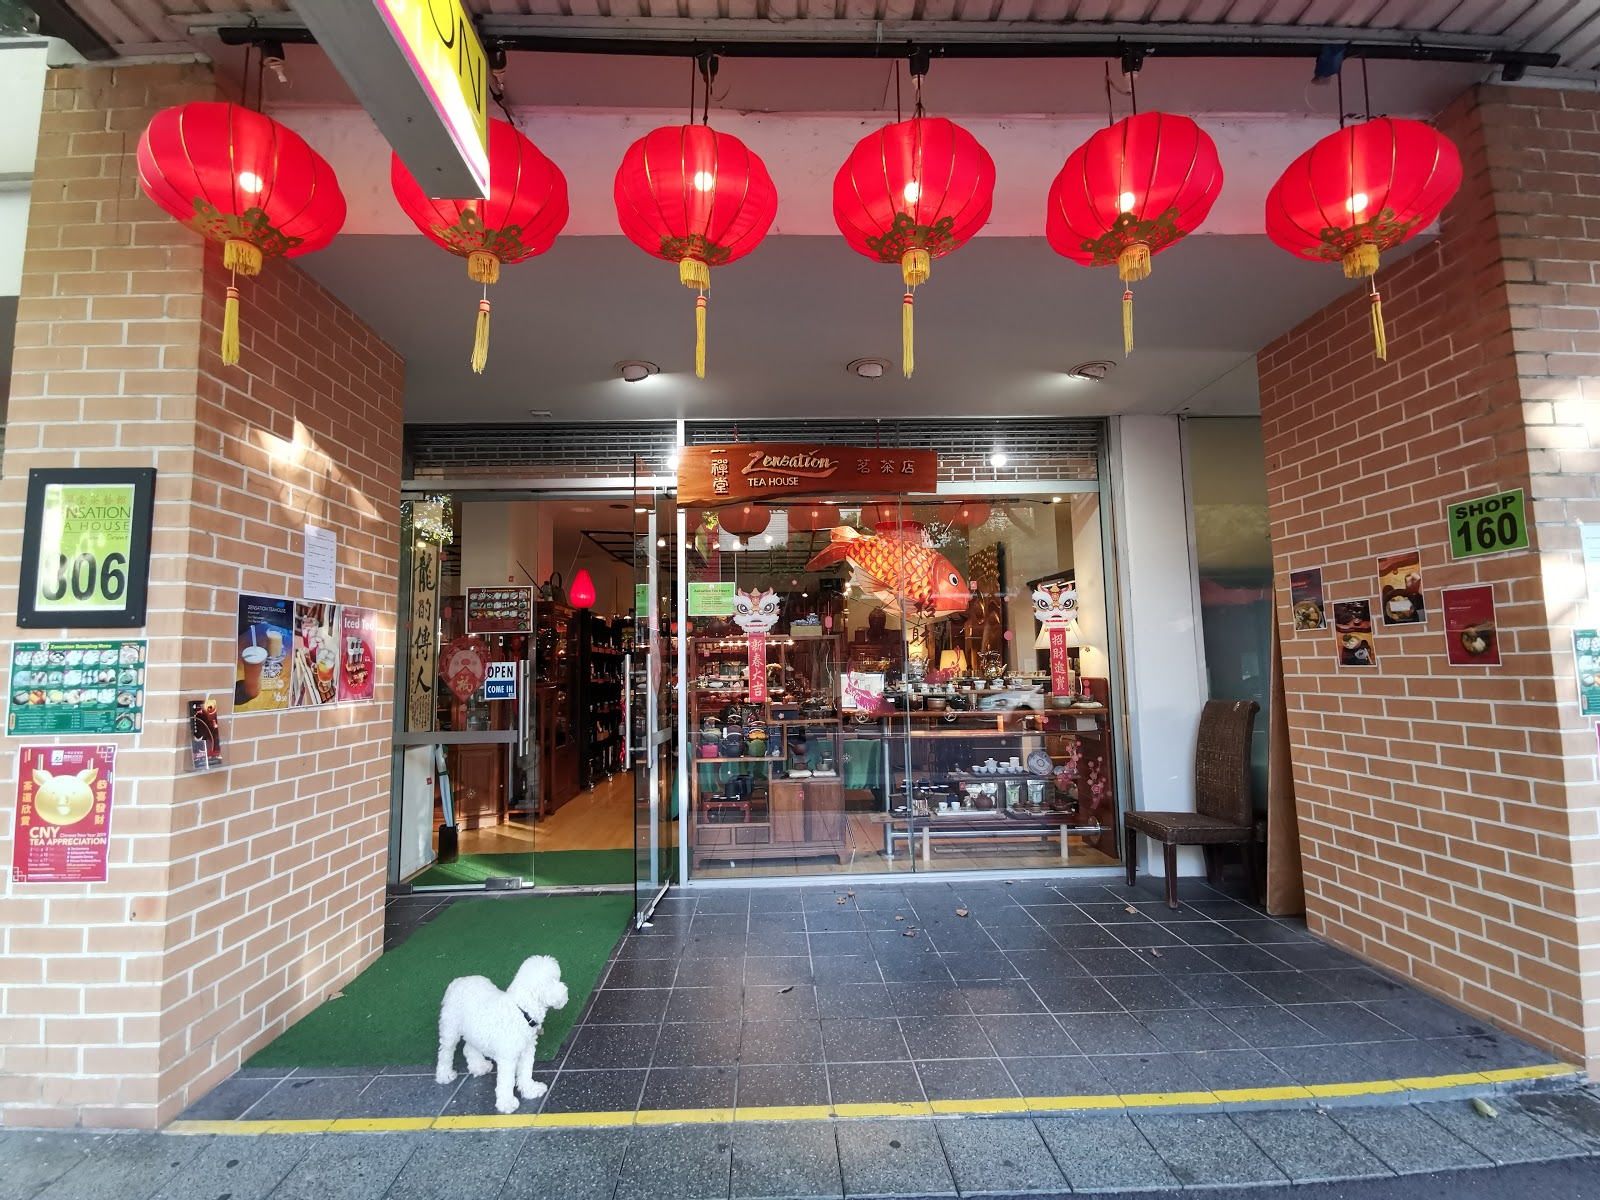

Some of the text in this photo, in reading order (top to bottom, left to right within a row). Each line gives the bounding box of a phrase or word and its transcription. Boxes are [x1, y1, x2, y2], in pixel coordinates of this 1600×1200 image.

[742, 449, 838, 478] Zensation
[857, 458, 915, 474] 茗茶店
[710, 449, 728, 494] 一禪堂
[748, 477, 799, 487] TEA HOUSE
[64, 506, 131, 519] NSATION
[1455, 495, 1516, 519] SHOP
[80, 521, 130, 531] HOUSE
[1457, 512, 1518, 552] 160
[42, 552, 127, 601] 806
[344, 617, 375, 630] Iced Tea
[487, 665, 514, 679] OPEN
[750, 638, 765, 697] 新春大吉
[487, 685, 513, 694] COME IN
[29, 826, 60, 839] CNY
[46, 837, 107, 846] APPRECIATION
